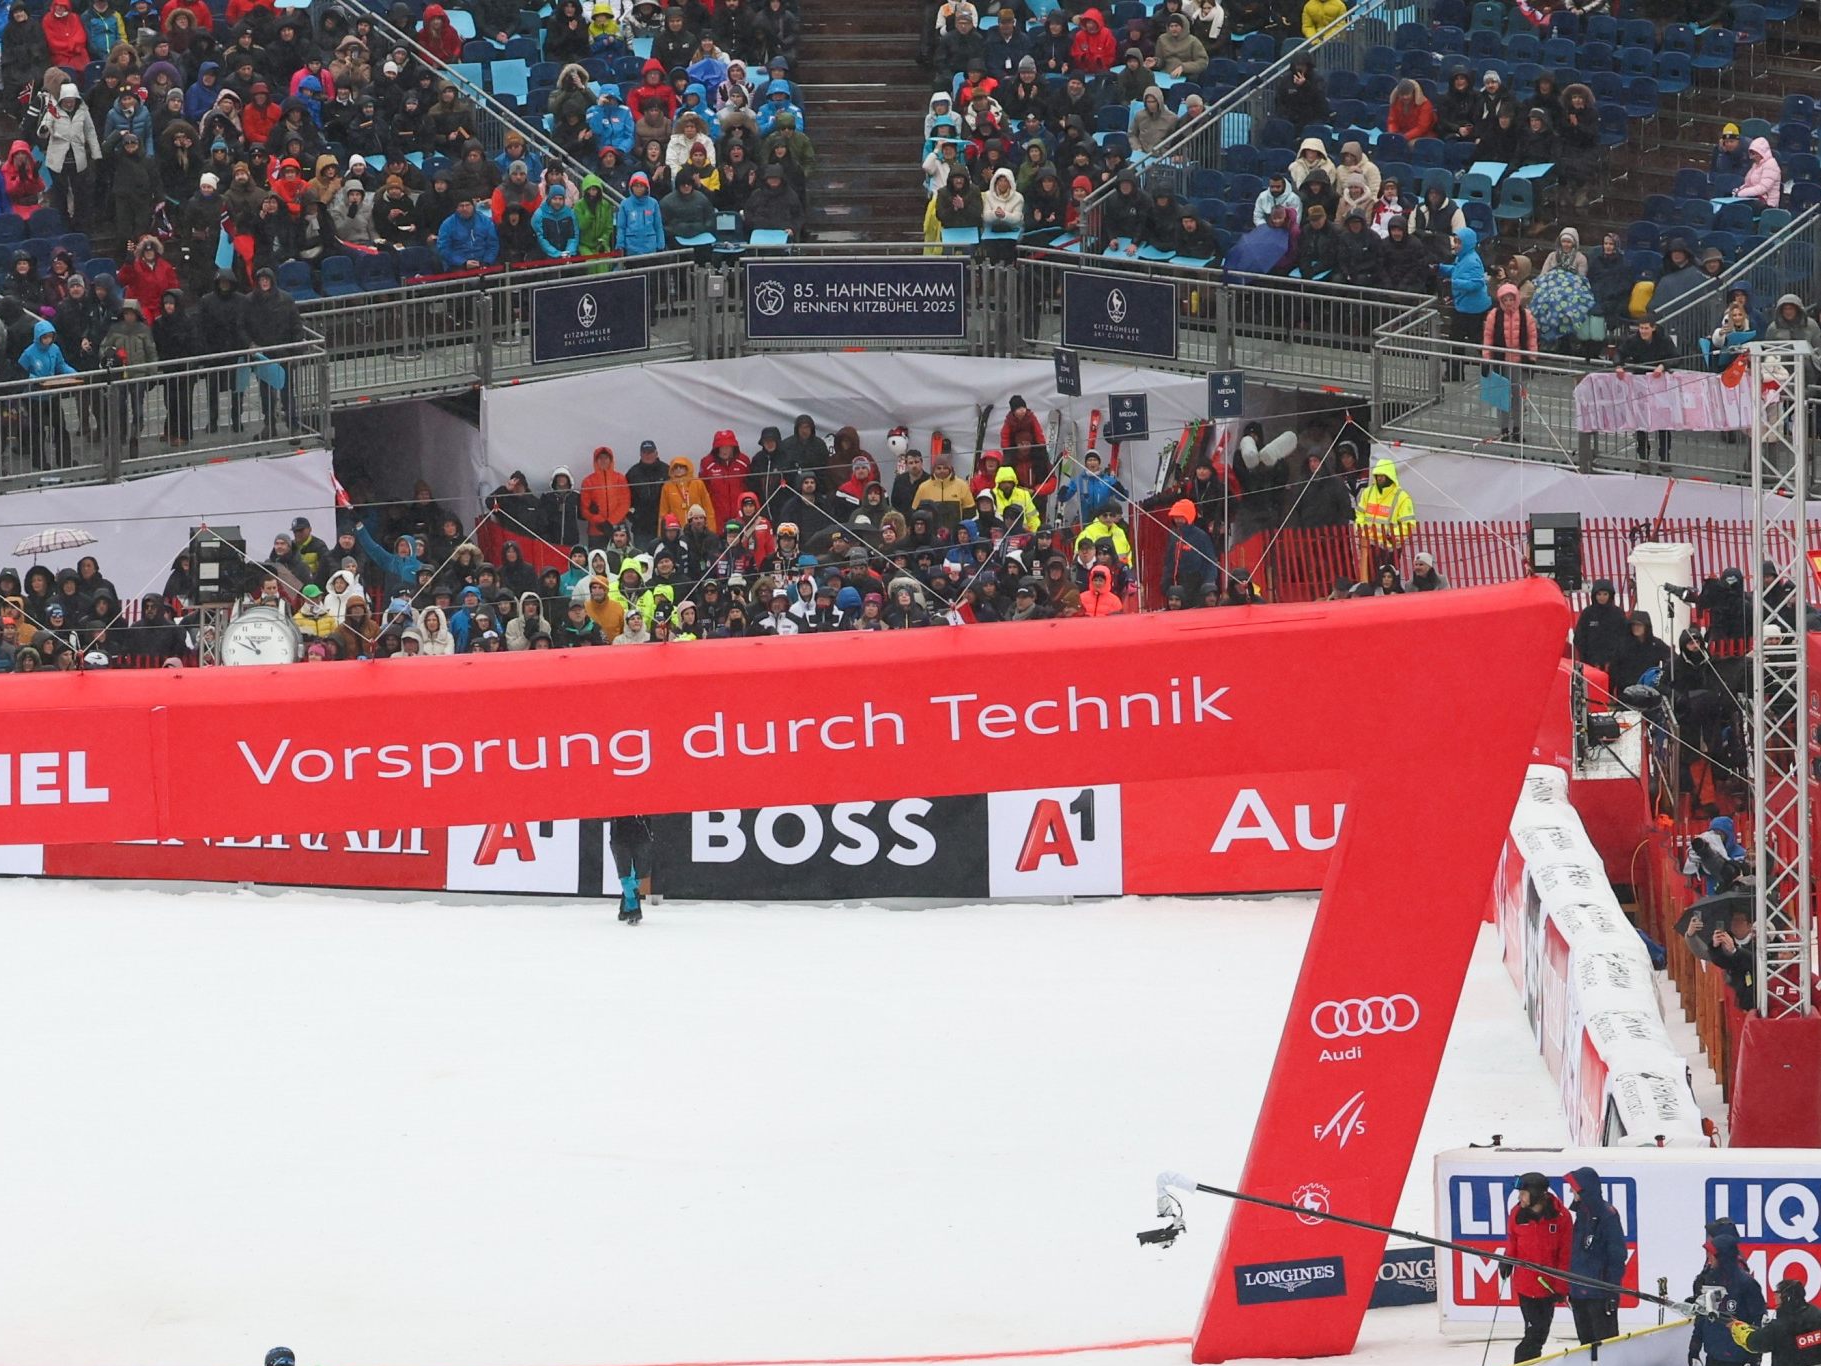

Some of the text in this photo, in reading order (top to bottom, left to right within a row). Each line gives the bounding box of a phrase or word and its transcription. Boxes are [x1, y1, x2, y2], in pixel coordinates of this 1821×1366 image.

[793, 283, 955, 298] 85. HAHNENKAMM
[793, 298, 955, 313] RENNEN KITZBÜHEL 2025
[1223, 399, 1230, 408] 5
[1126, 423, 1132, 431] 3
[236, 676, 1233, 788] Vorsprung durch Technik
[1209, 788, 1345, 853] Au
[691, 798, 936, 866] BOSS
[1015, 788, 1096, 873] A1
[1318, 1046, 1362, 1063] Audi
[1244, 1264, 1336, 1287] LONGINES
[1797, 1333, 1821, 1347] ORF
